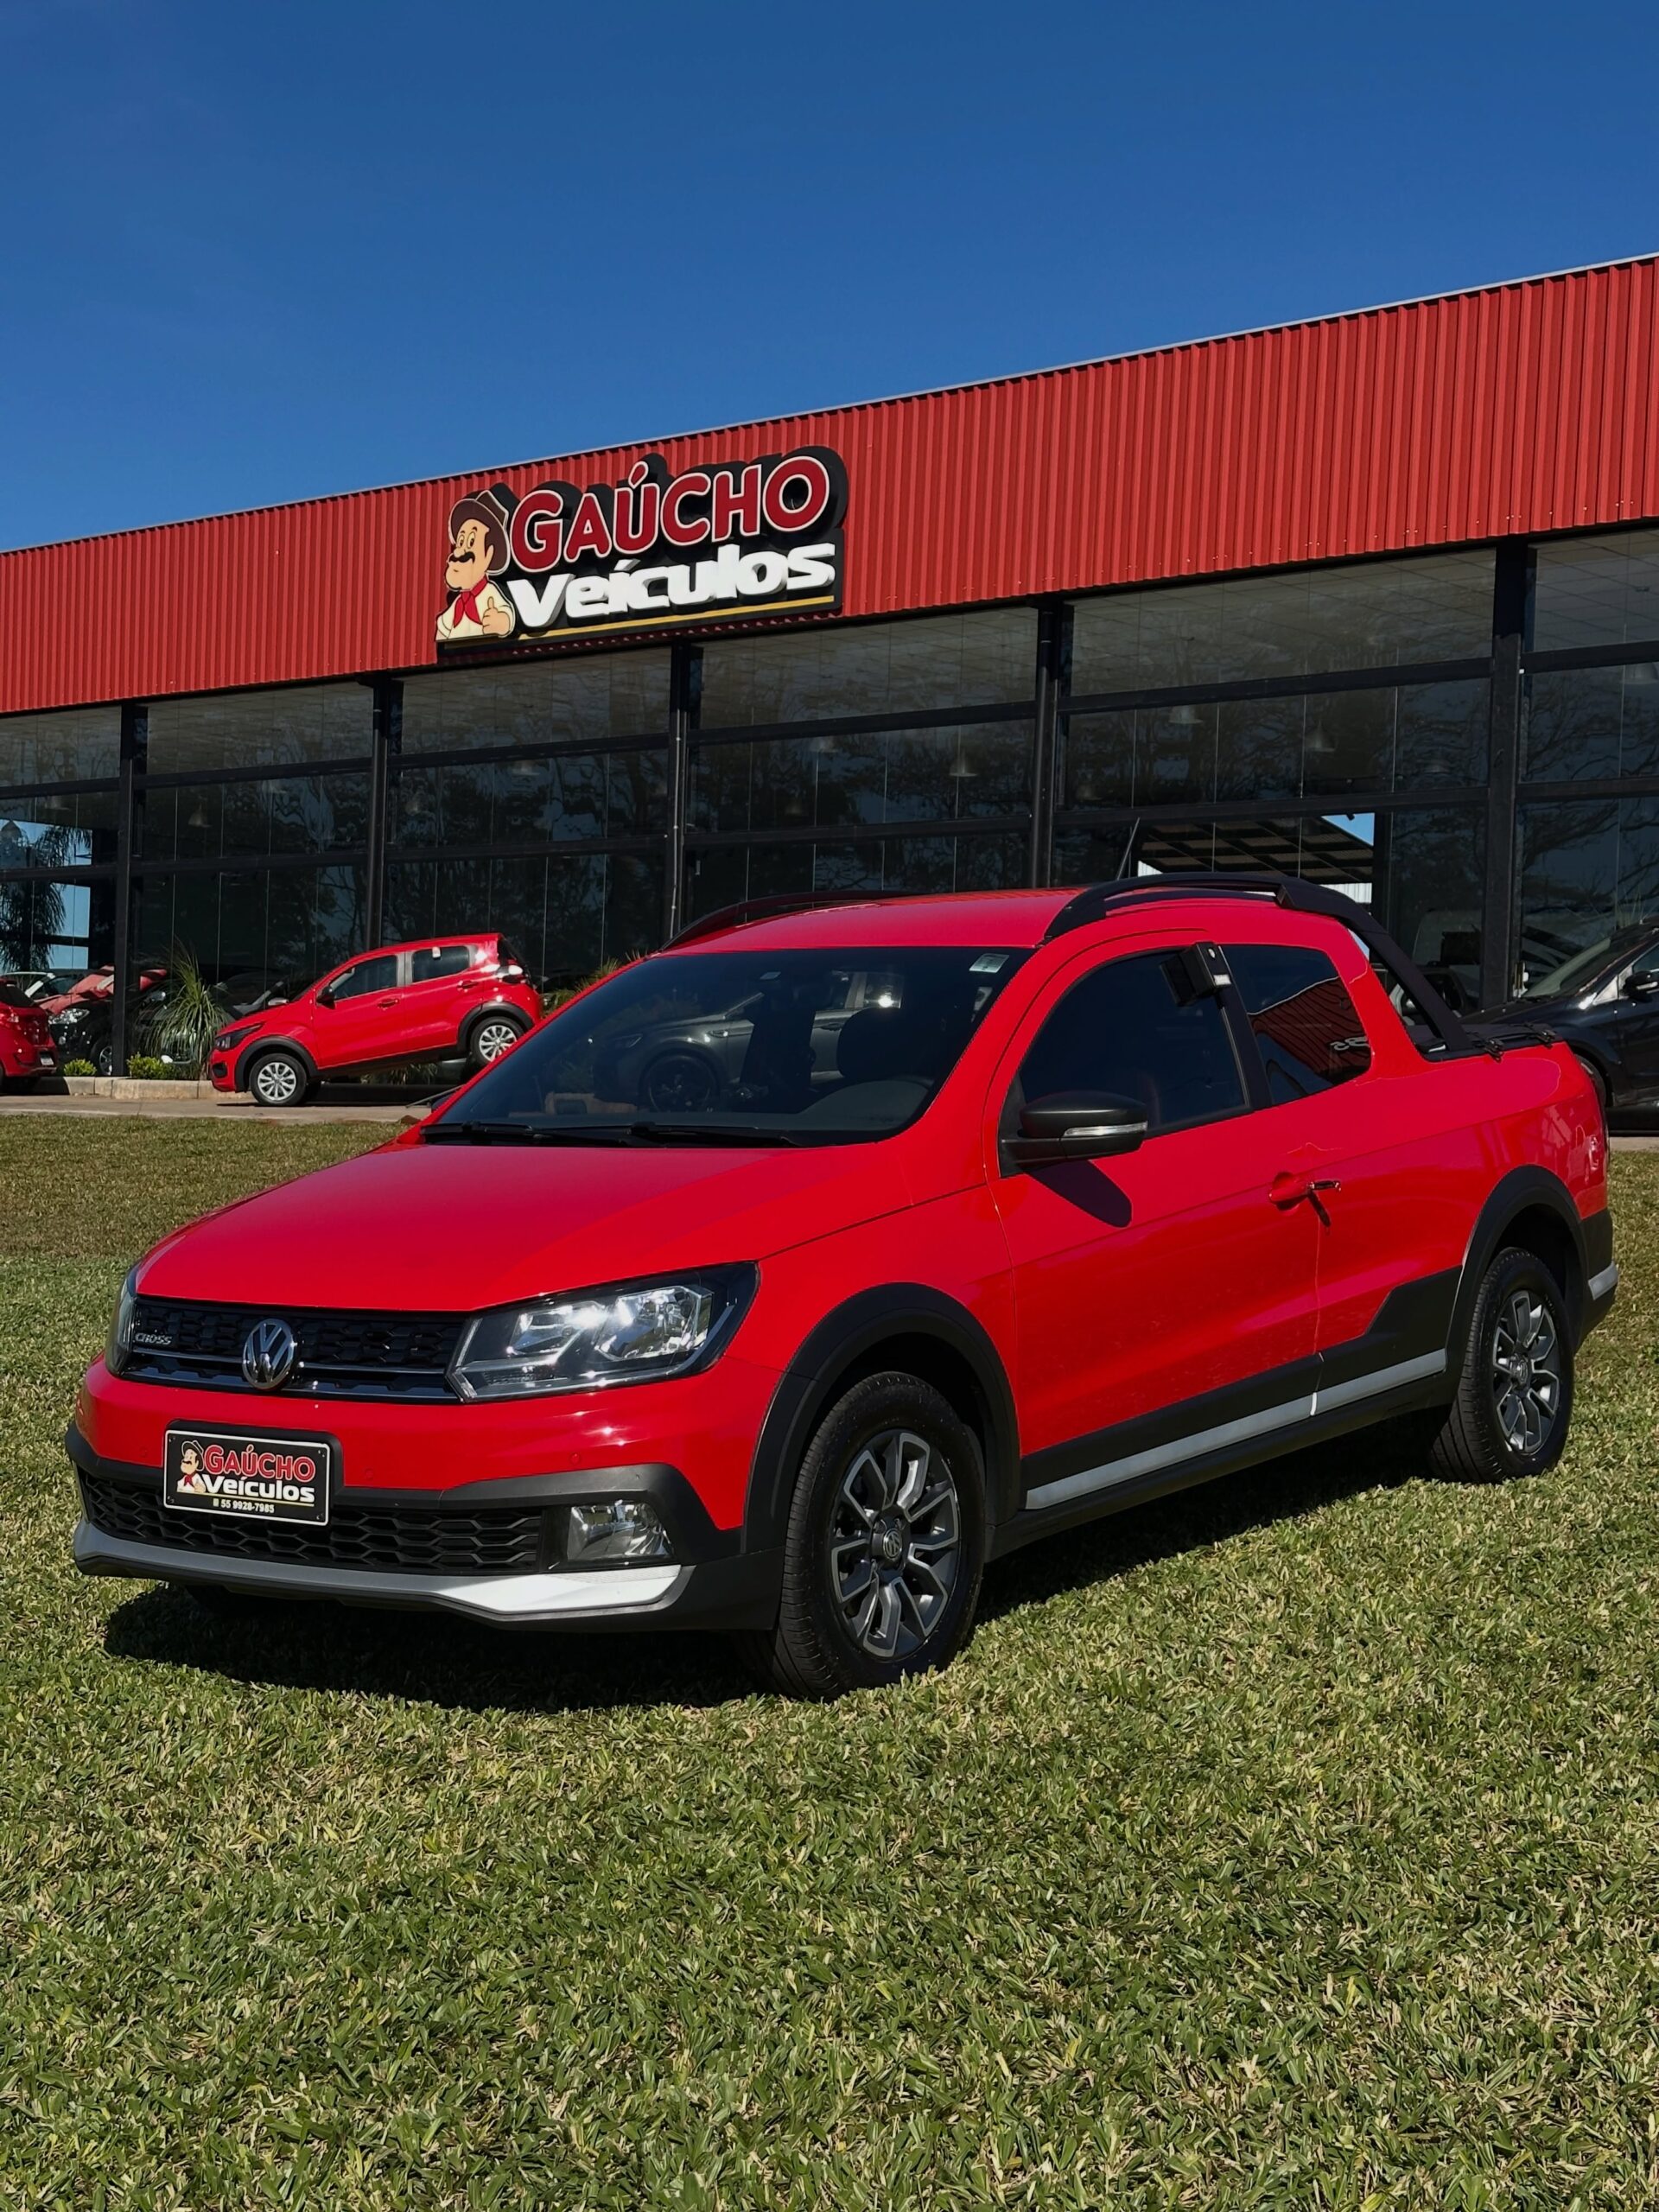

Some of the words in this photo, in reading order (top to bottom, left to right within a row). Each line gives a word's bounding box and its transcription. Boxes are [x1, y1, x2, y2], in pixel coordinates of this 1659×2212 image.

[510, 456, 830, 573] GAÚCHO
[506, 543, 836, 628] Veículos
[135, 1332, 172, 1345] CROSS
[203, 1444, 316, 1483] GAÚCHO
[202, 1474, 315, 1503] Veículos
[220, 1498, 232, 1509] 55
